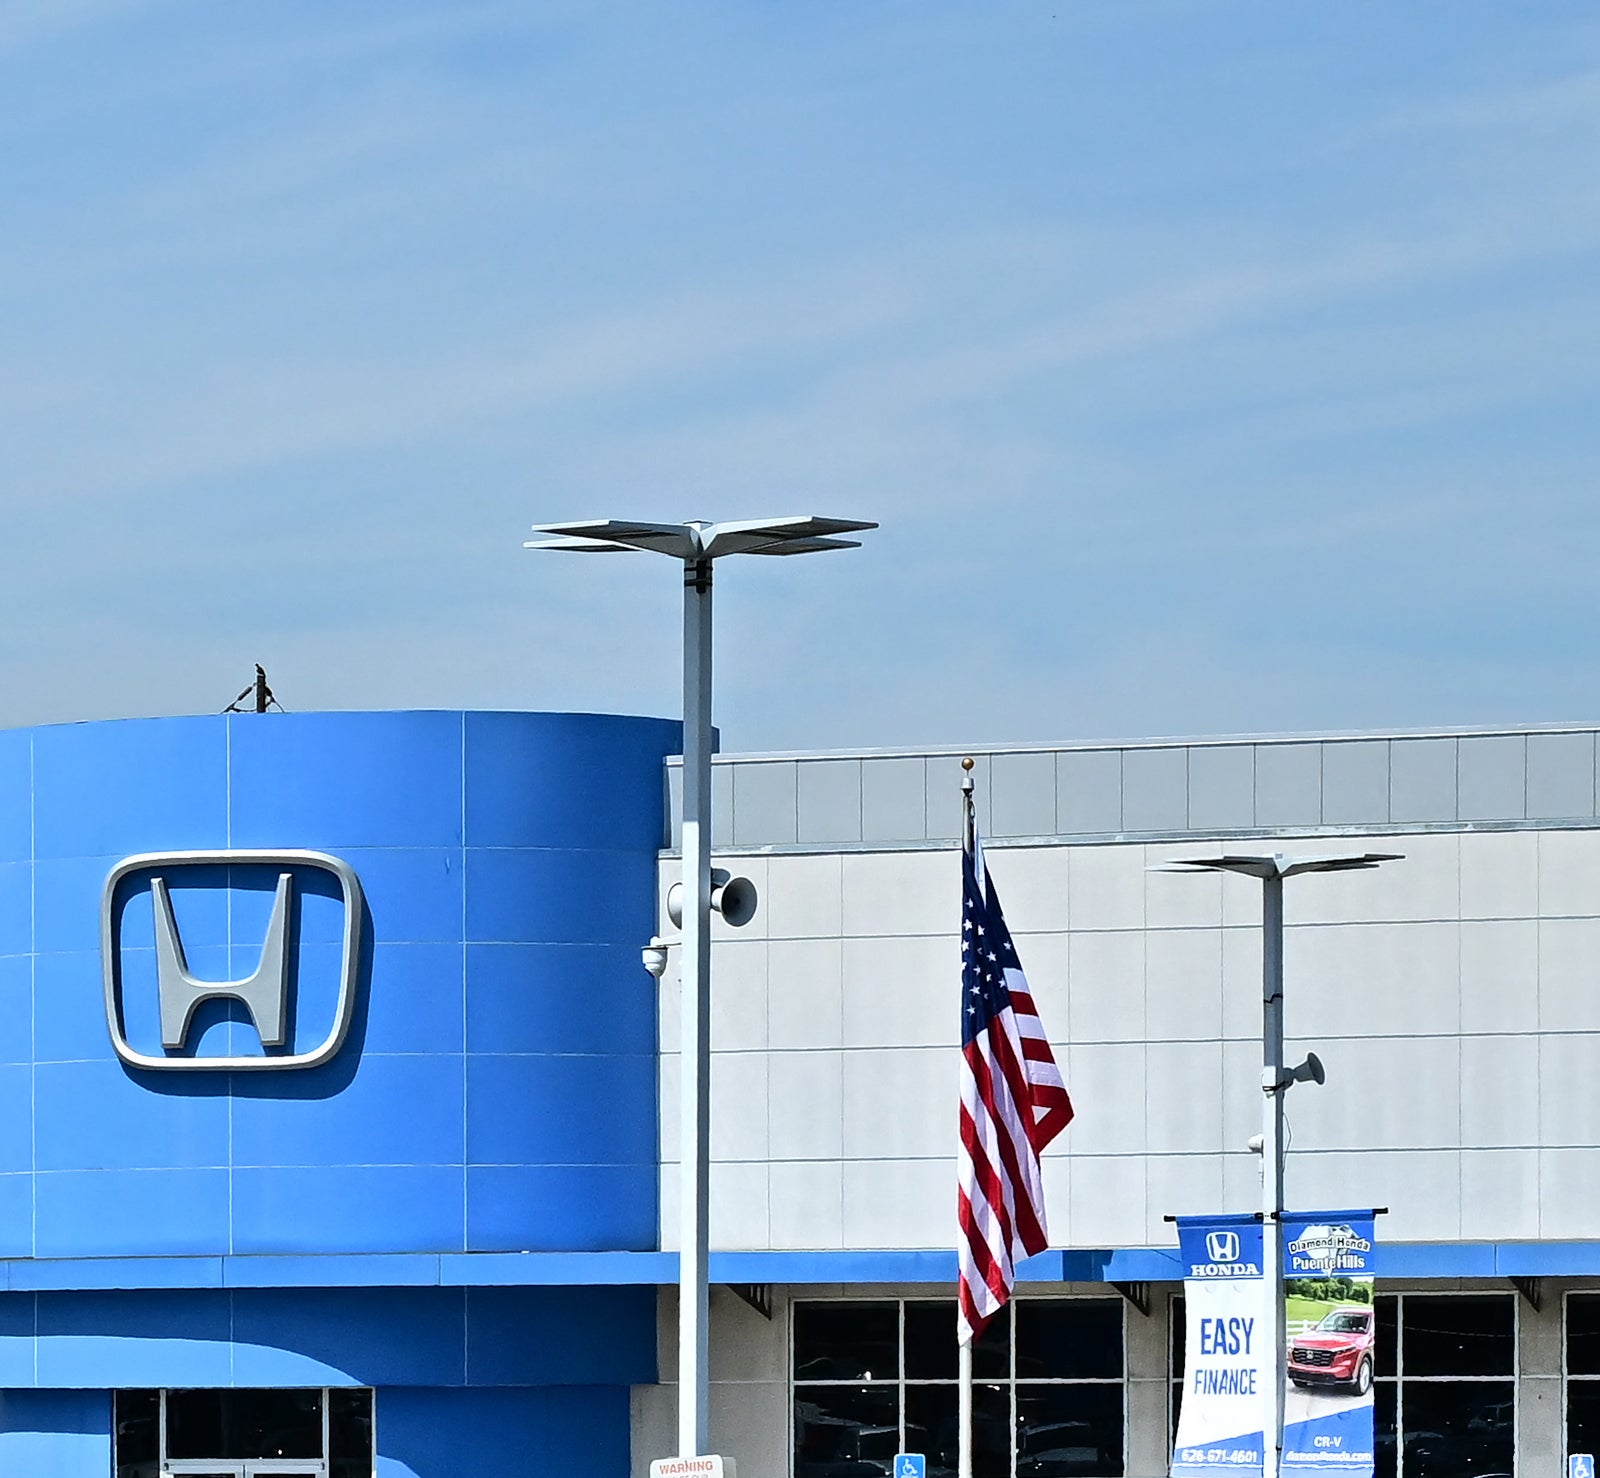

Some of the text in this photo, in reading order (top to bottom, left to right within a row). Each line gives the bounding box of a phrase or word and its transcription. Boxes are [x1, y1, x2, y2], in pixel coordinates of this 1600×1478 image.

[1290, 1237, 1370, 1252] Diamond Honda
[1191, 1263, 1259, 1276] HONDA
[1292, 1254, 1365, 1270] Puente Hills
[1200, 1317, 1254, 1356] EASY
[1194, 1368, 1257, 1395] FINANCE
[1313, 1435, 1343, 1448] CR-V
[659, 1460, 713, 1474] WARNING
